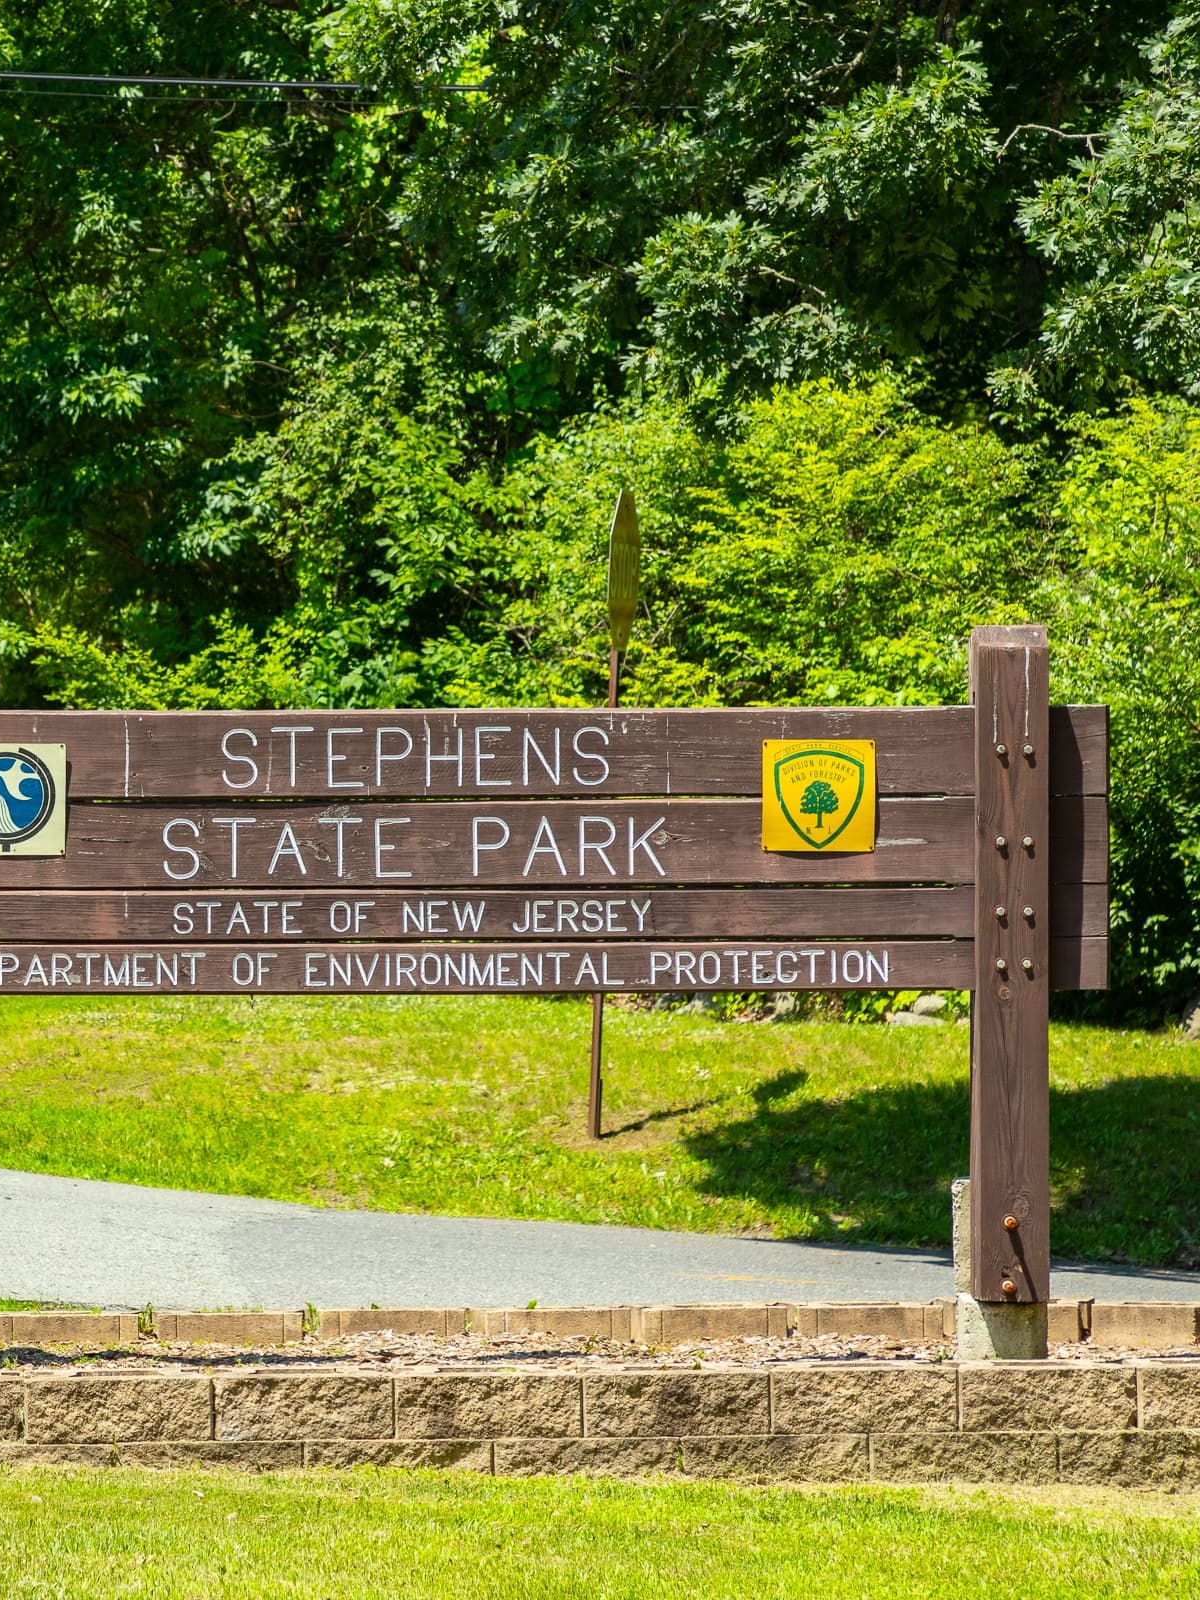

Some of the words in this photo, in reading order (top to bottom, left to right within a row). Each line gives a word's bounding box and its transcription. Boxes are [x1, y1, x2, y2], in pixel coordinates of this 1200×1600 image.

[221, 727, 609, 788] STEPHENS
[782, 760, 815, 775] DIVISION
[818, 760, 827, 768] OF
[831, 762, 856, 776] PARKS
[791, 772, 806, 784] AND
[809, 770, 847, 784] FORESTRY
[162, 817, 412, 880] STATE
[472, 816, 666, 877] PARK
[173, 901, 302, 934] STATE
[329, 901, 375, 934] OF
[403, 900, 486, 933] NEW
[513, 899, 652, 933] JERSEY
[232, 952, 278, 986] OF
[305, 951, 625, 986] ENVIRONMENTAL
[650, 950, 889, 984] PROTECTION
